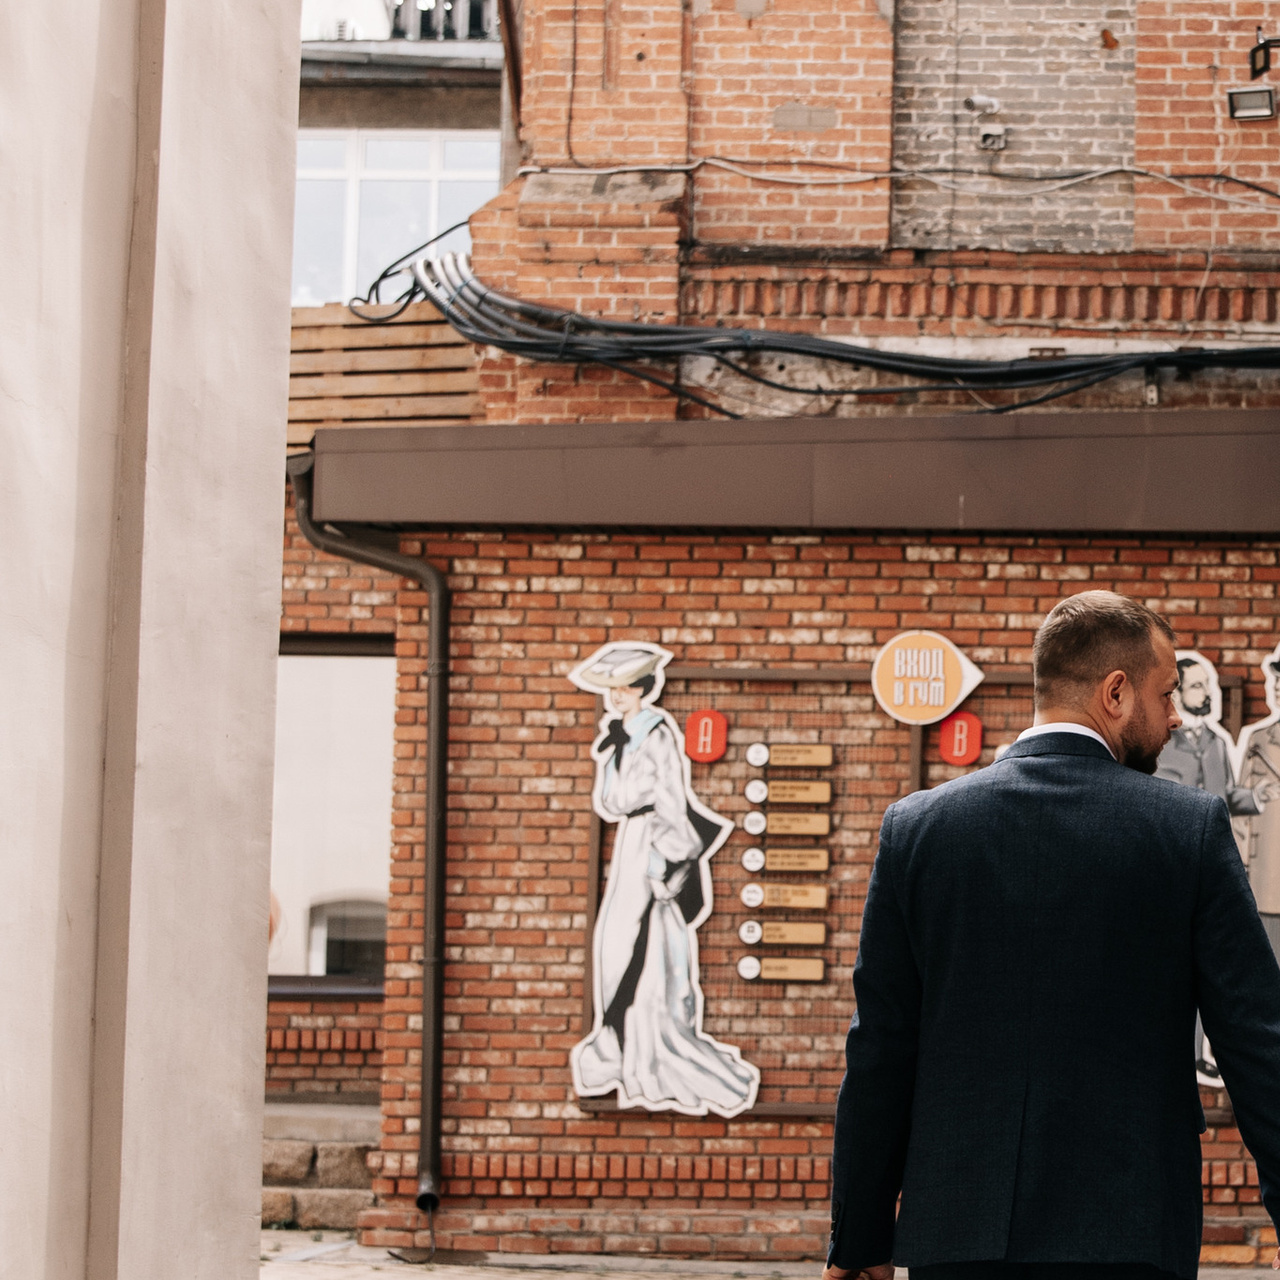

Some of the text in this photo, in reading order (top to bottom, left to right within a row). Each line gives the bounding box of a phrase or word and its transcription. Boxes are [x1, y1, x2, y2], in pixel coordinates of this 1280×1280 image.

[893, 647, 945, 681] ВХОД
[893, 680, 945, 707] В ГУМ
